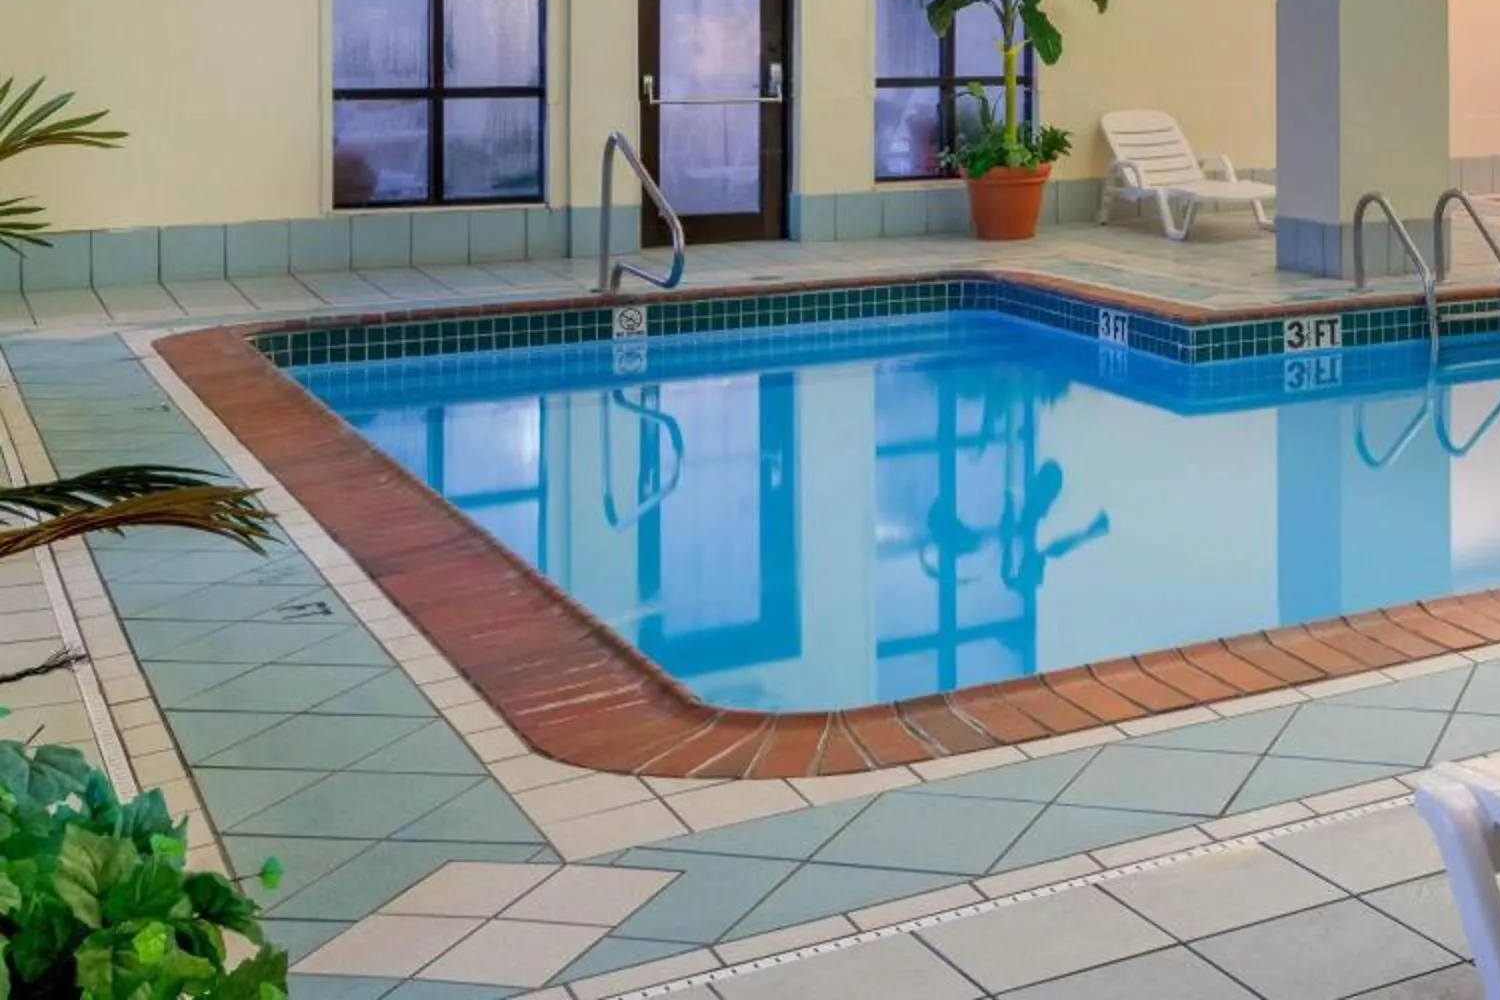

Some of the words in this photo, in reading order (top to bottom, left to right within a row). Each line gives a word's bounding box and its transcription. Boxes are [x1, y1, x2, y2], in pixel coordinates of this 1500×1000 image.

[1101, 311, 1111, 337] 3
[1113, 315, 1127, 341] FT
[1287, 320, 1305, 349] 3
[1315, 317, 1339, 347] FT
